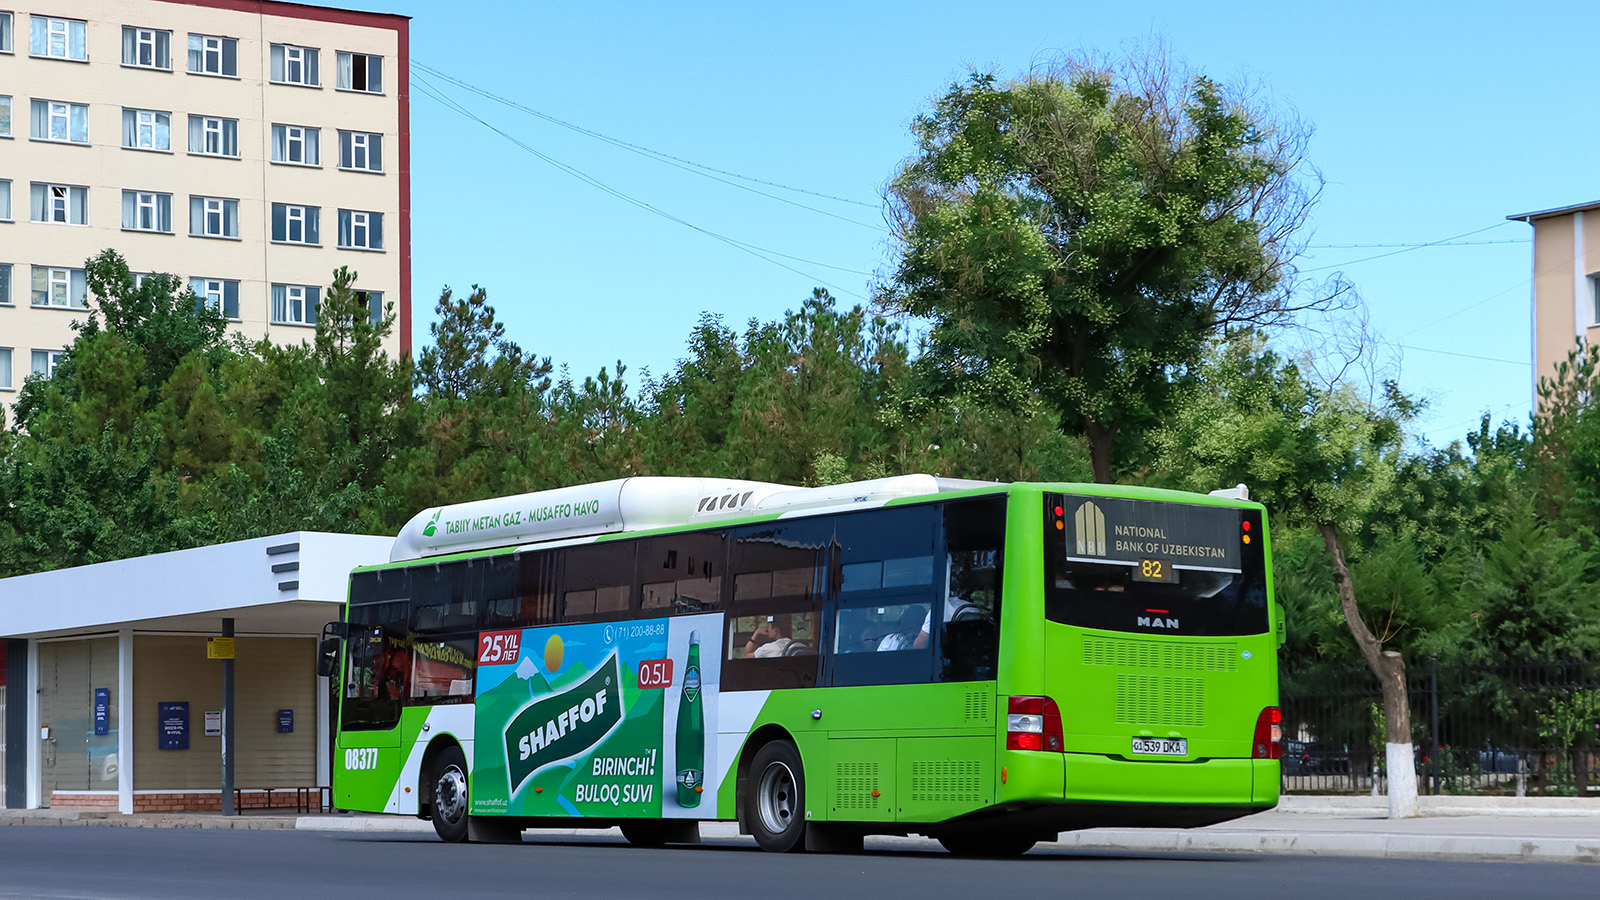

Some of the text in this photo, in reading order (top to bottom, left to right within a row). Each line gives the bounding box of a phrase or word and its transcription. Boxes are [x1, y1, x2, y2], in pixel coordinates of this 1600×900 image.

[445, 518, 471, 535] TABIIY
[471, 514, 501, 531] METAN
[503, 511, 521, 527] GAZ
[528, 503, 571, 523] MUSAFFO
[573, 499, 600, 517] HAVO
[1115, 525, 1167, 539] NATIONAL
[1115, 541, 1225, 558] BANK OF UZBEKISTAN
[1142, 560, 1162, 578] 82
[615, 624, 665, 640] (71) 200-88-88
[1137, 616, 1179, 629] MAN
[480, 635, 503, 662] 25
[504, 634, 519, 649] YIL
[640, 663, 670, 685] 0.5L
[518, 688, 608, 761] SHAFFOF
[1144, 740, 1161, 752] 539
[1163, 742, 1181, 753] DKA
[344, 748, 379, 771] 08377
[592, 748, 657, 776] BIRINCHI!
[575, 783, 653, 807] BULOQ SUVI
